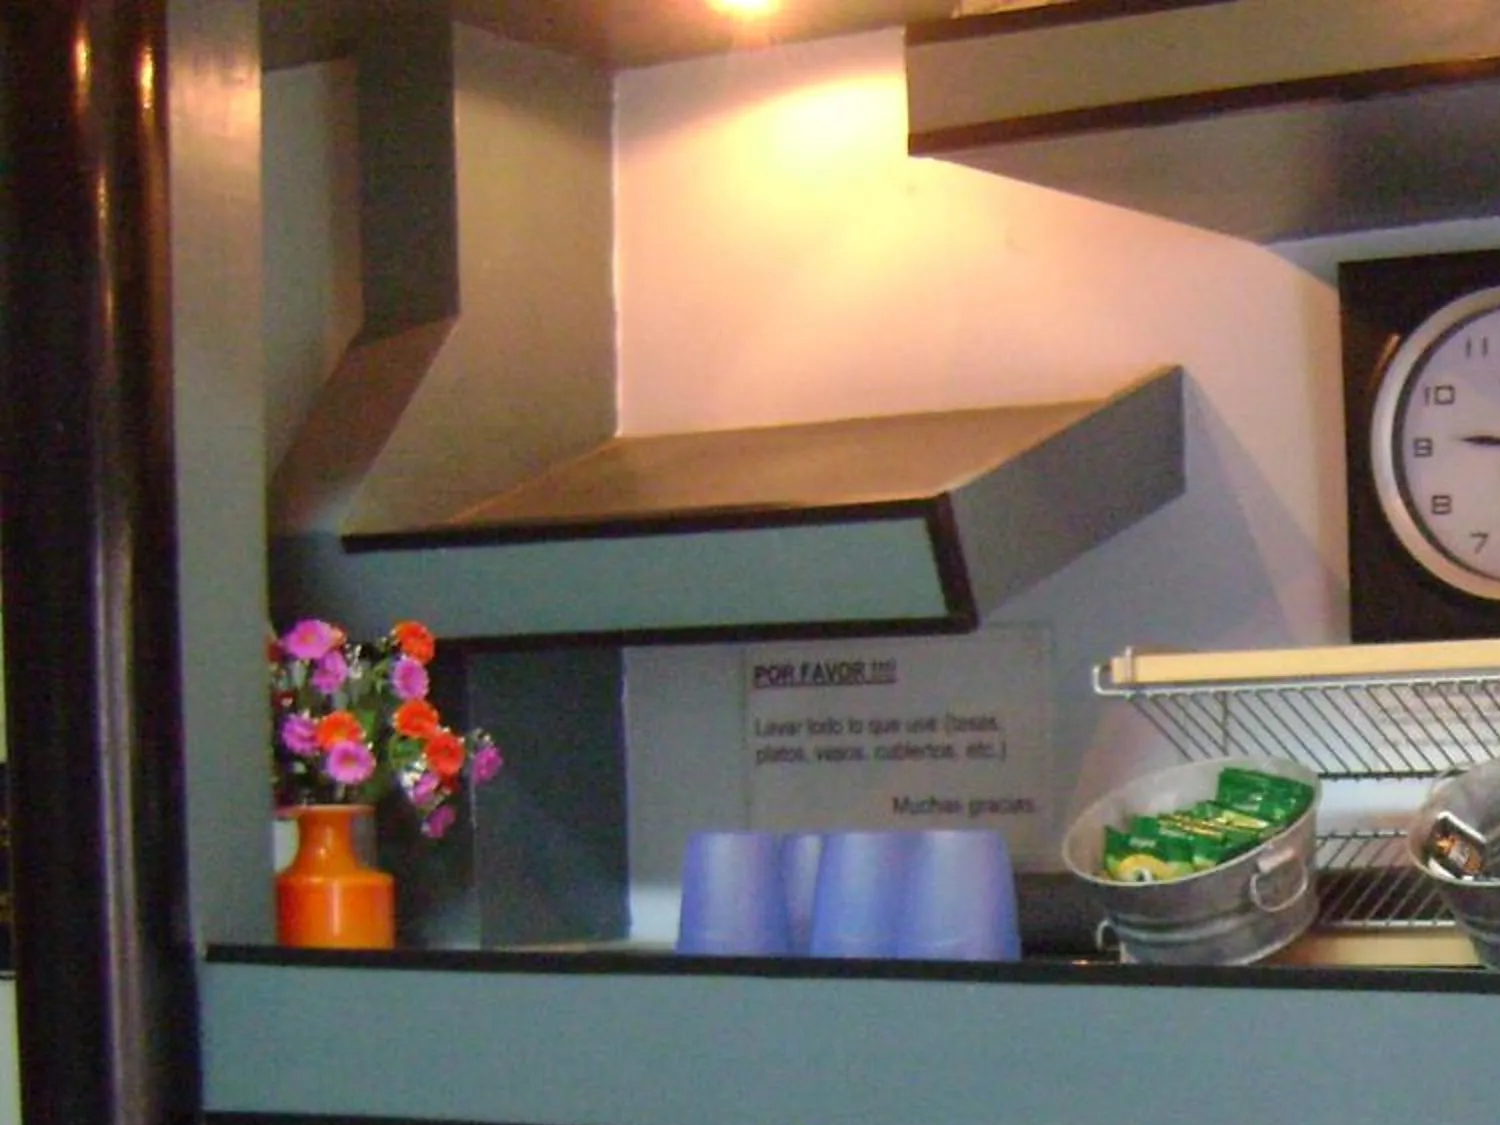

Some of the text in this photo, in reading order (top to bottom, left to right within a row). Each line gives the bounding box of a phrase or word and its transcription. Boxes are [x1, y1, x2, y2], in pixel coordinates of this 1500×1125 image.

[1465, 336, 1489, 357] 11
[1424, 384, 1455, 405] 10
[1413, 438, 1433, 458] 9
[1431, 495, 1452, 515] 8
[1470, 532, 1489, 553] 7
[753, 664, 795, 685] POR
[800, 661, 865, 684] FAVOR
